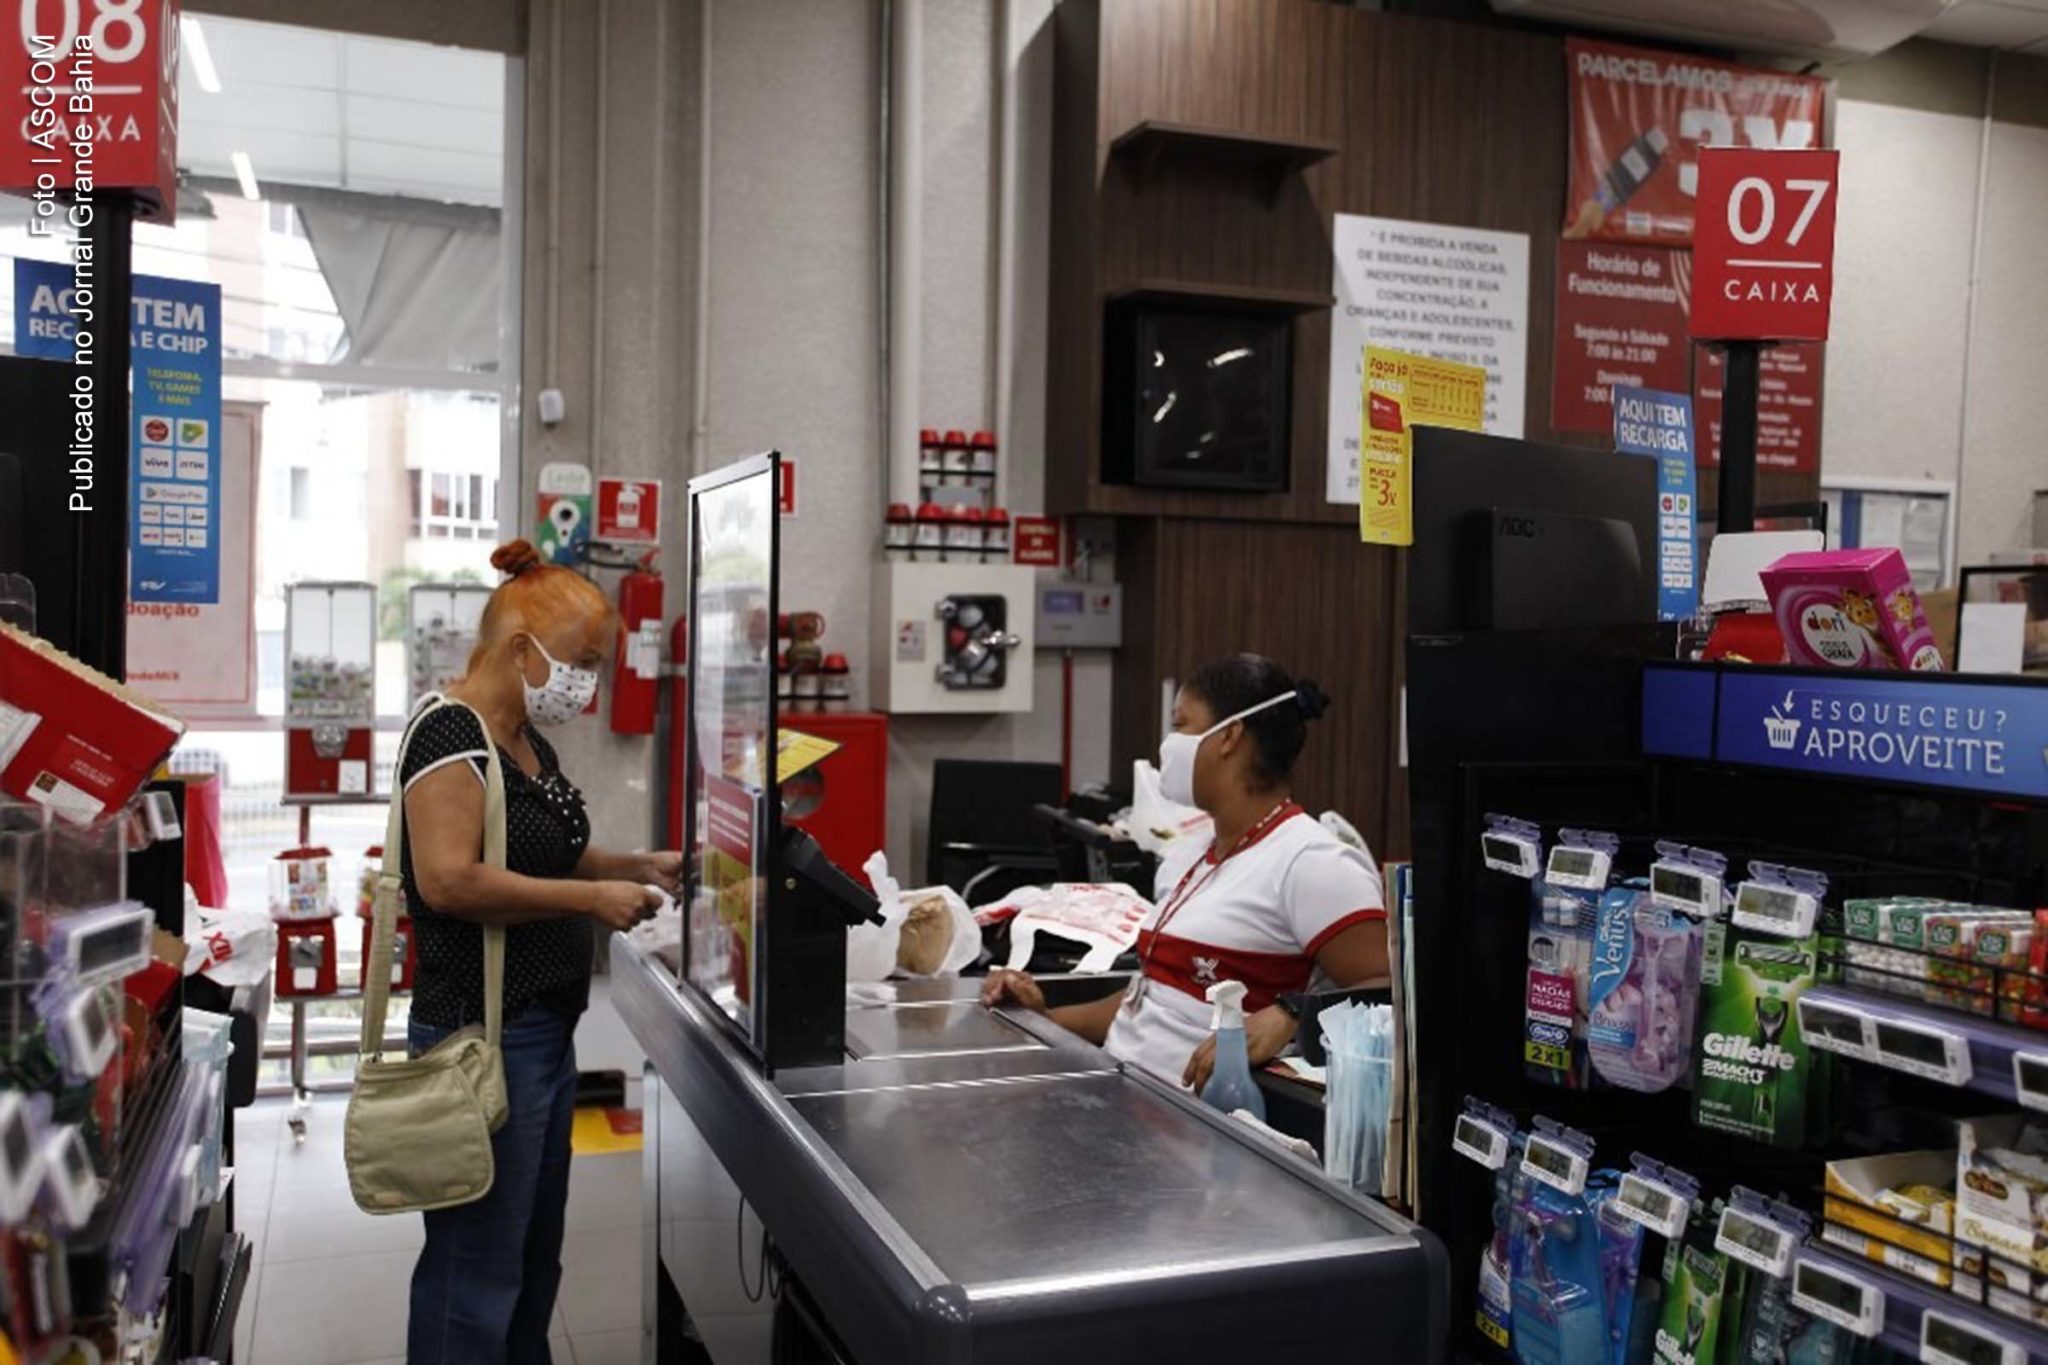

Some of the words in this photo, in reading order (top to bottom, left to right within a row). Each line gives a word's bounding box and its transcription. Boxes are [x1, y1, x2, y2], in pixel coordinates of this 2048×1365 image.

[20, 0, 146, 63] 08
[1577, 51, 1733, 92] PARCELAMOS
[1726, 176, 1831, 247] 07
[1377, 250, 1429, 267] BEBIDAS
[1567, 272, 1678, 303] Funcionamento
[1724, 279, 1820, 303] CAIXA
[132, 297, 206, 332] TEM
[142, 332, 154, 348] E
[158, 332, 208, 354] CHIP
[1619, 396, 1654, 422] AQUI
[1656, 402, 1687, 428] TEM
[1620, 421, 1688, 453] RECARGA
[1807, 610, 1847, 633] dori
[1810, 699, 2008, 733] ESQUECEU?
[1803, 726, 2006, 775] APROVEITE
[1594, 906, 1630, 983] Venus
[1703, 1032, 1795, 1072] Gillette
